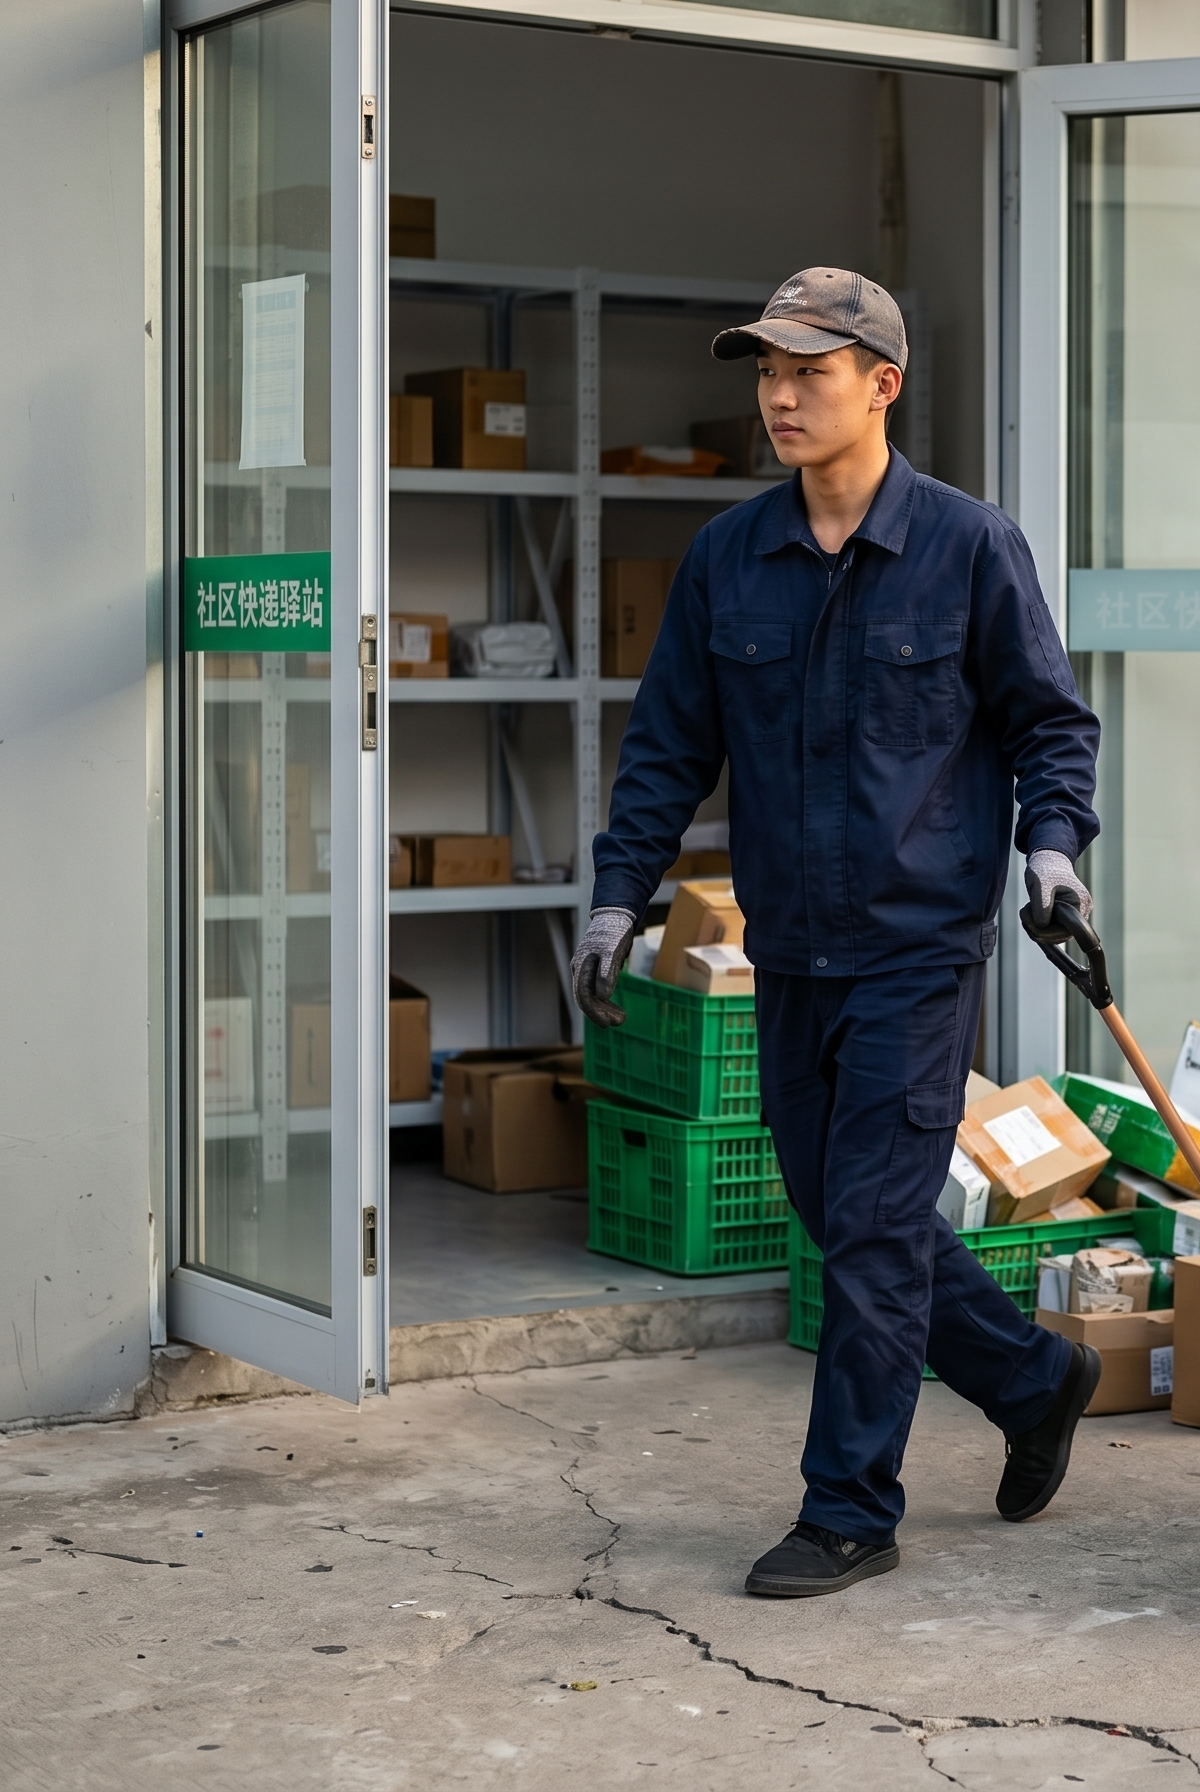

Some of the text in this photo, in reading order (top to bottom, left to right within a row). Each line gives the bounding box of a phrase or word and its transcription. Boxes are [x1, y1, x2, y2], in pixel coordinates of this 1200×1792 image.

[196, 577, 324, 629] 社区快递驿站
